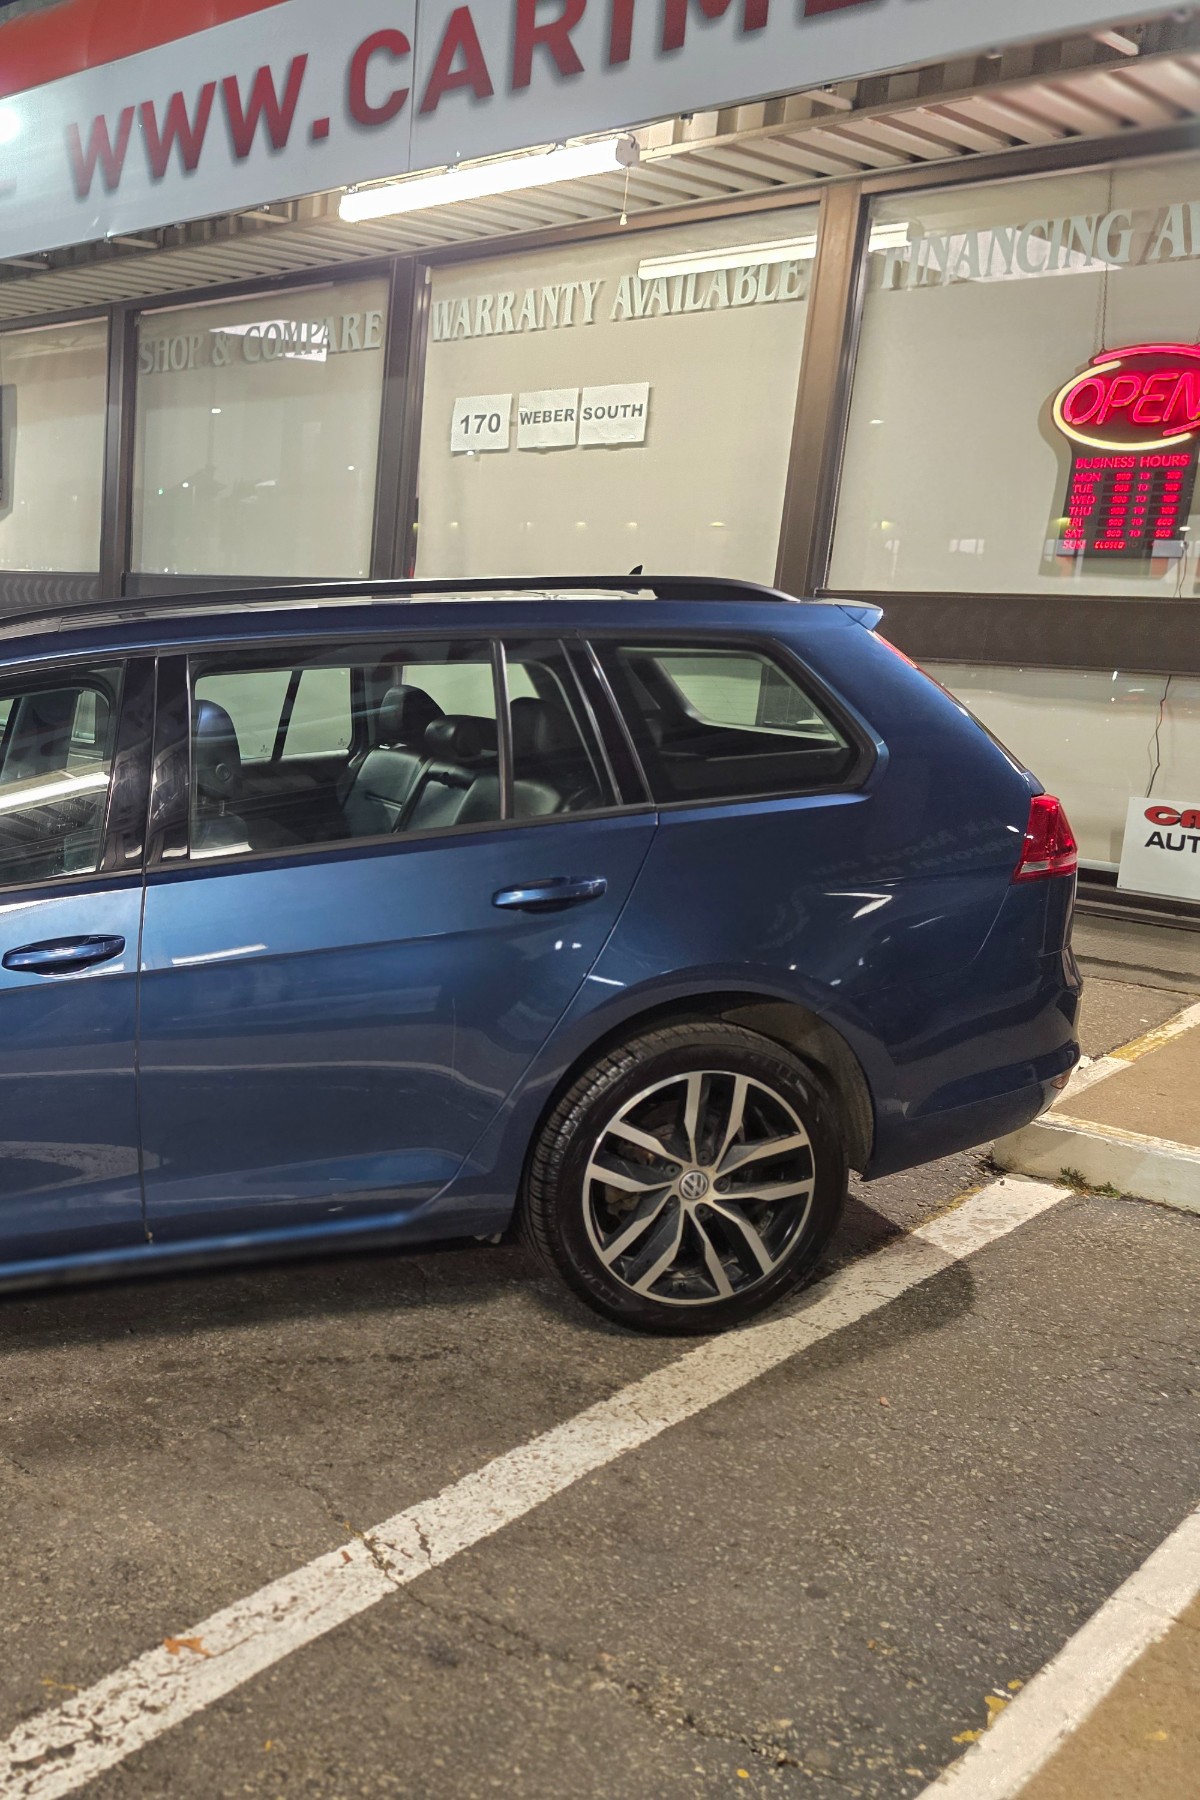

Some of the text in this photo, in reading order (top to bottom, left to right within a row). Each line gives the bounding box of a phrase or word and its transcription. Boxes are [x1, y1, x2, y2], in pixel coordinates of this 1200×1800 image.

[881, 208, 1134, 290] FINANCING
[431, 260, 803, 341] WARRANTY AVAILABLE
[139, 310, 383, 375] SHOP & COMPARE
[1063, 371, 1200, 425] OPEN
[519, 403, 644, 426] WEBER SOUTH
[460, 412, 501, 436] 170
[1075, 454, 1189, 469] BUSINESS HOURS
[1073, 472, 1102, 482] MON
[1072, 484, 1094, 494] TUE
[1070, 495, 1097, 505] WED
[1068, 506, 1093, 516] THU
[1066, 517, 1083, 527] FRI
[1064, 529, 1085, 538] SAT
[1062, 540, 1126, 550] SUN CLOSED
[1144, 831, 1200, 854] AUT
